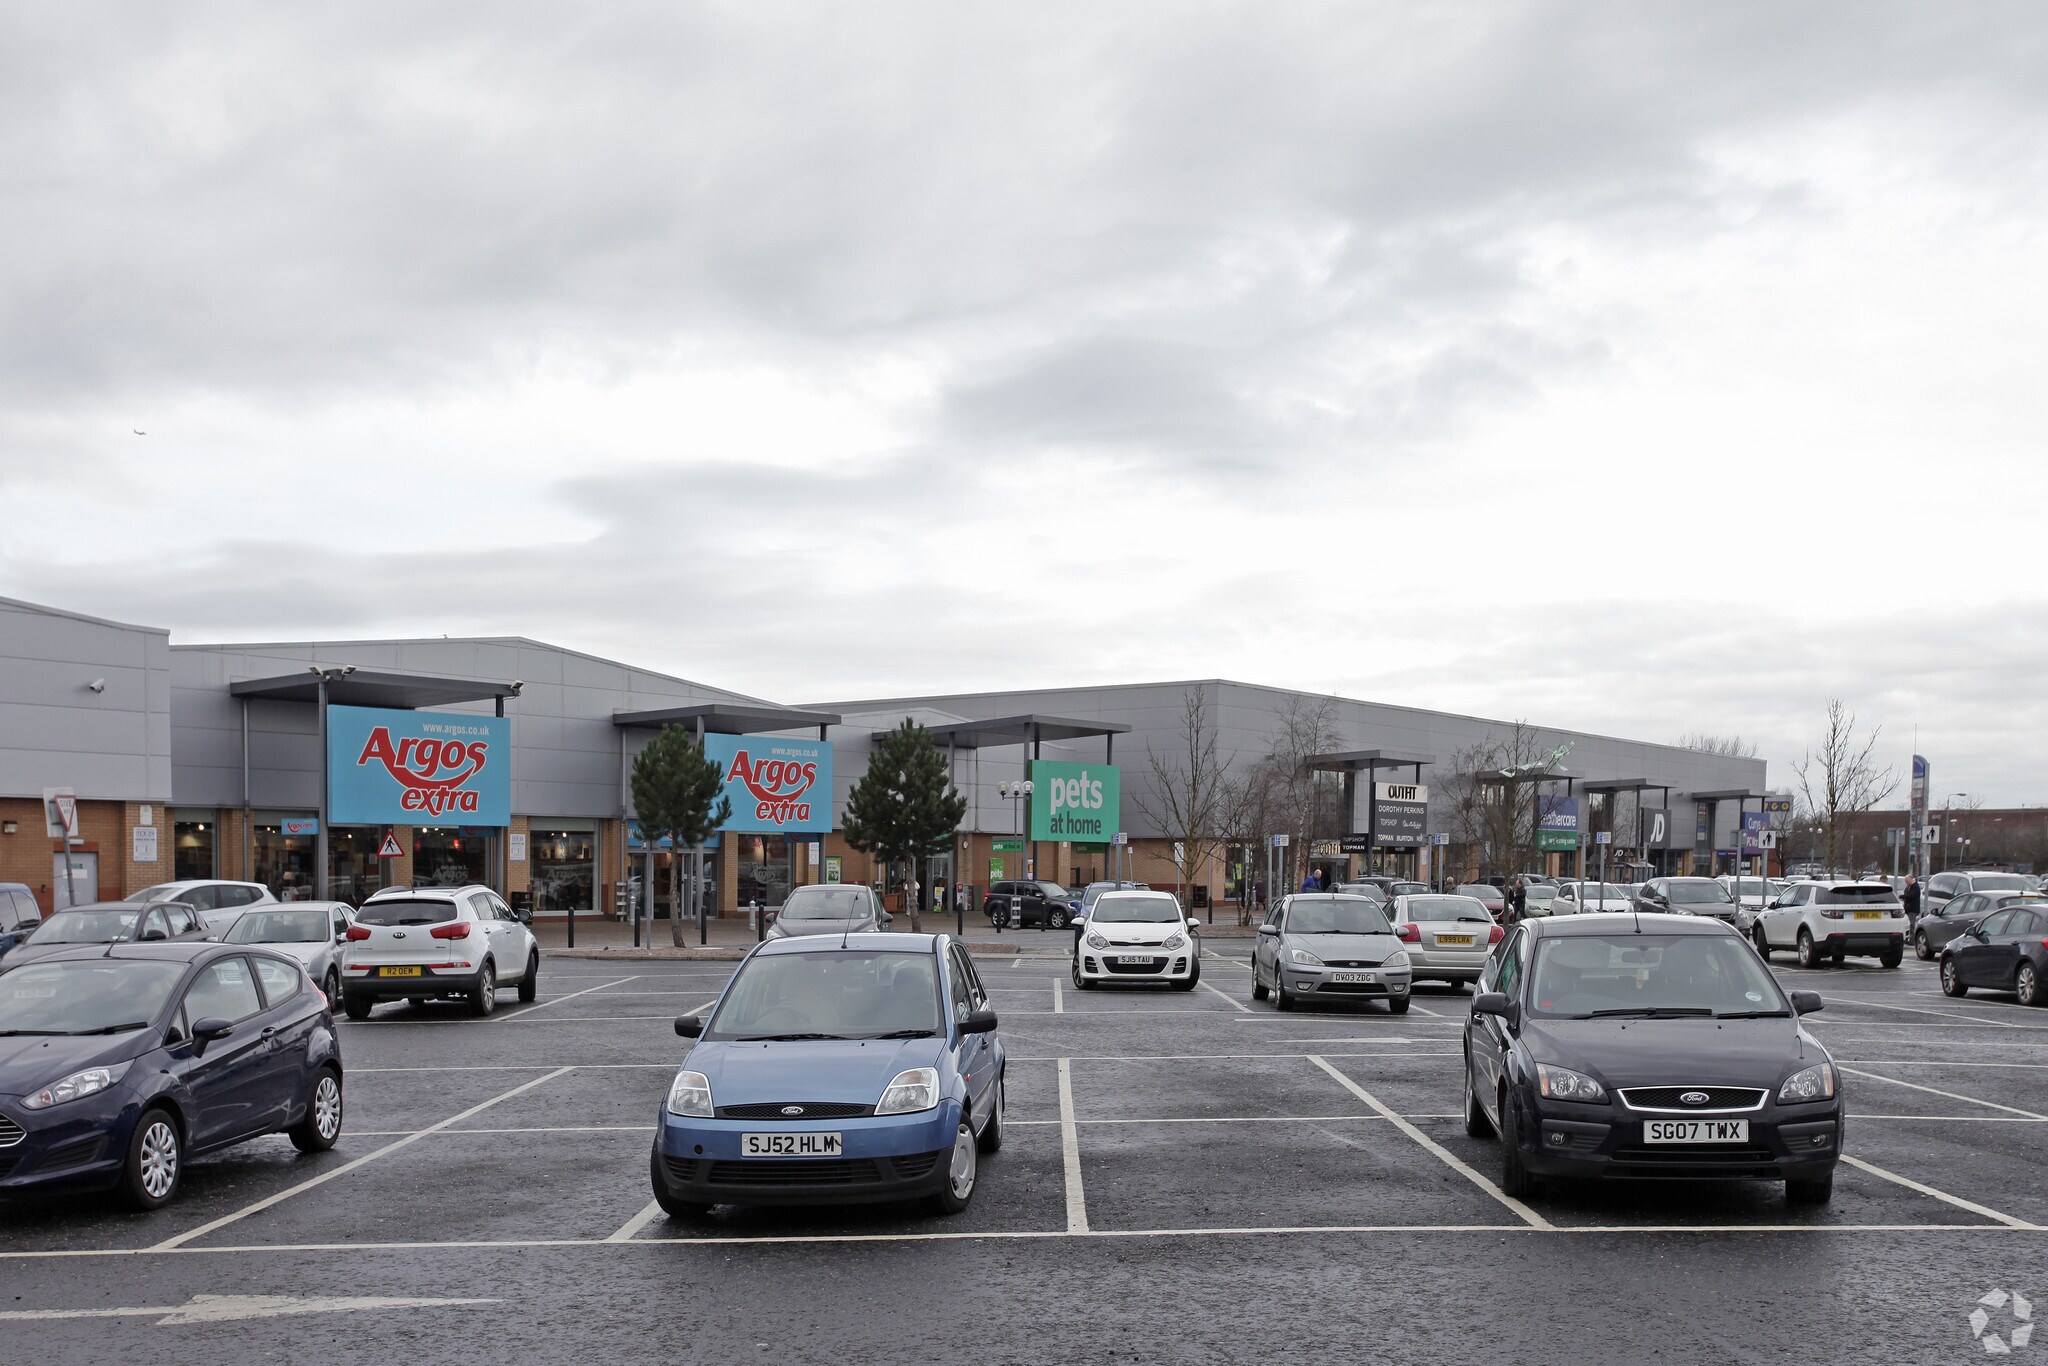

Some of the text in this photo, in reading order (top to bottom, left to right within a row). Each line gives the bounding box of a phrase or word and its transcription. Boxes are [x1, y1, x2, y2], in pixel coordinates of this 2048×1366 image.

[422, 723, 490, 736] www.argos.co.uk
[356, 726, 489, 790] Argos
[771, 747, 819, 758] www.argos.co.uk
[725, 750, 818, 803] Argos
[1050, 770, 1103, 815] pets
[400, 786, 480, 817] extra
[1378, 805, 1424, 815] DOROTHY PERKINS
[755, 799, 811, 825] extra
[1050, 811, 1101, 834] at home
[1380, 818, 1398, 827] TOPSHOP
[1650, 813, 1665, 842] JD
[387, 967, 397, 975] R2
[1686, 1093, 1703, 1102] Ford
[785, 1106, 799, 1114] Ford
[1651, 1122, 1740, 1140] SG07 TWX
[749, 1136, 835, 1153] SJ52 HLM
